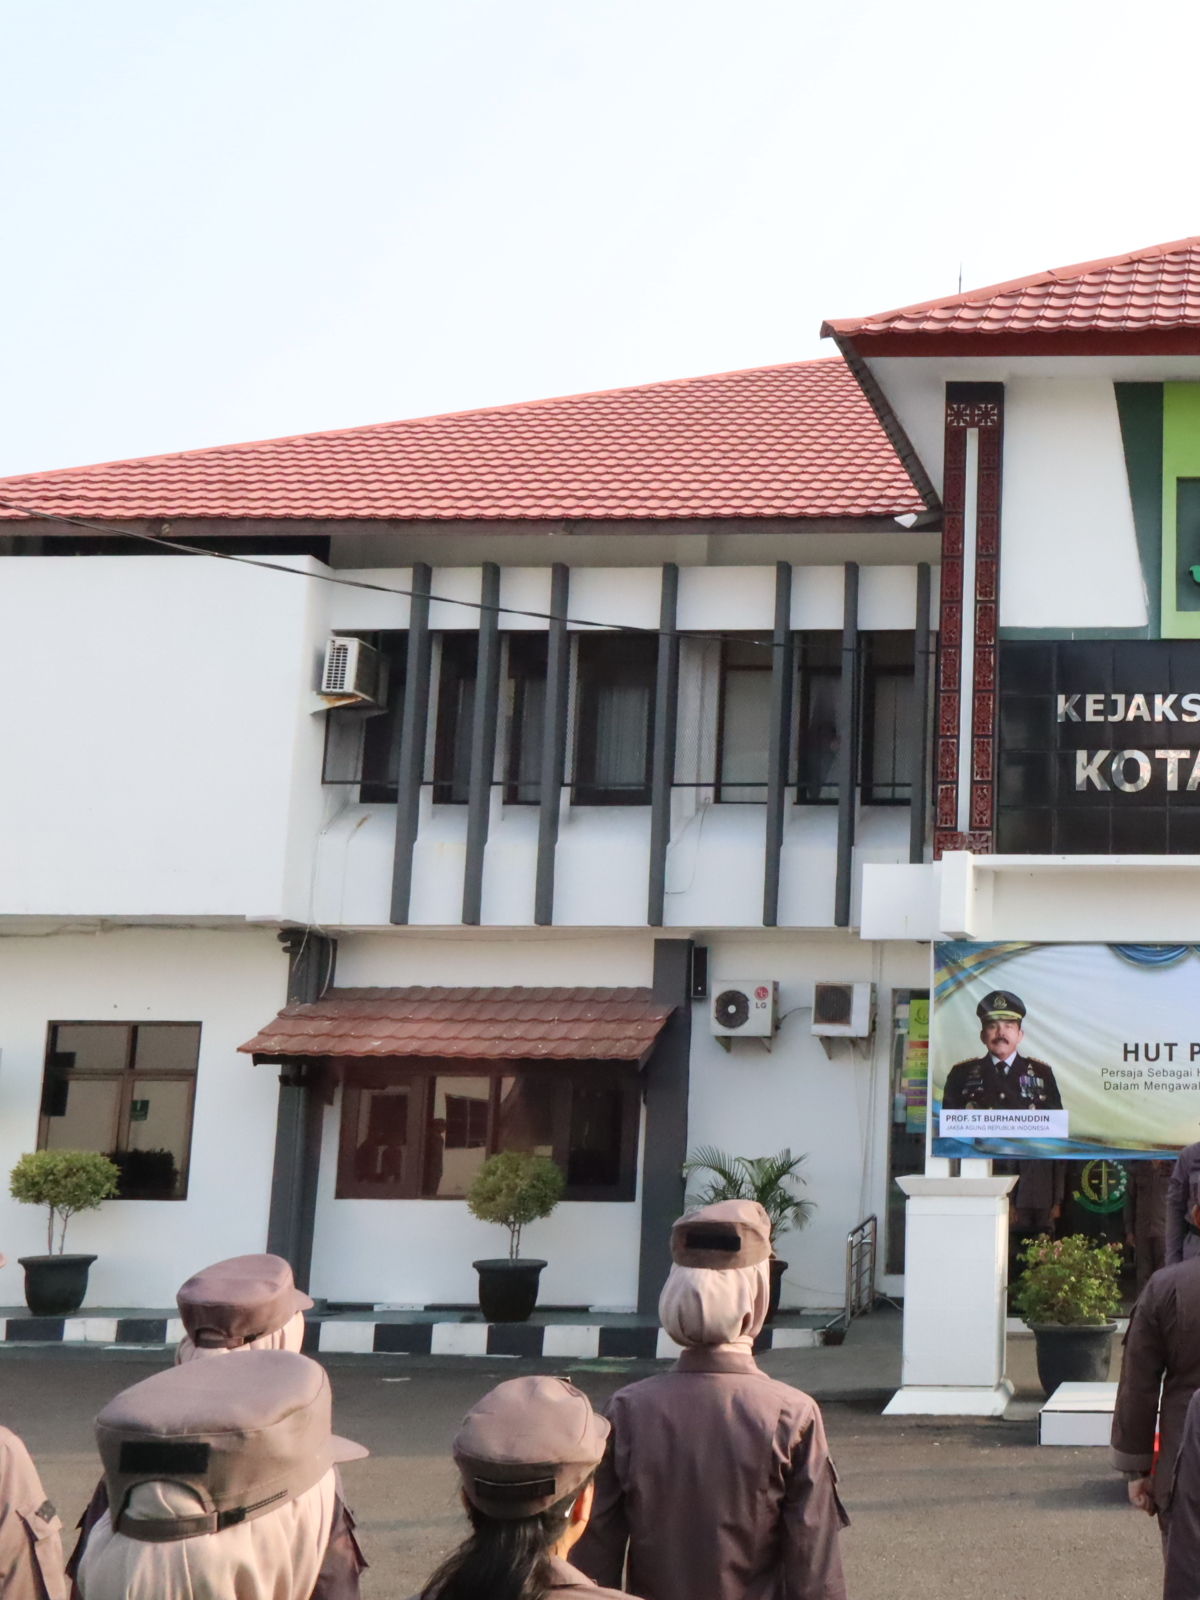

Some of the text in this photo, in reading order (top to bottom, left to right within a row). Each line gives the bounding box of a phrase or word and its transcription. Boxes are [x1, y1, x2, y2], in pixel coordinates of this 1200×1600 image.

[1123, 1042, 1178, 1062] HUT
[1101, 1068, 1143, 1079] Persaja
[1147, 1068, 1193, 1079] Sebagai
[1104, 1081, 1140, 1091] Dalam
[1144, 1081, 1200, 1092] Mengawal
[945, 1114, 1050, 1122] PROF. ST BURHANUDDIN
